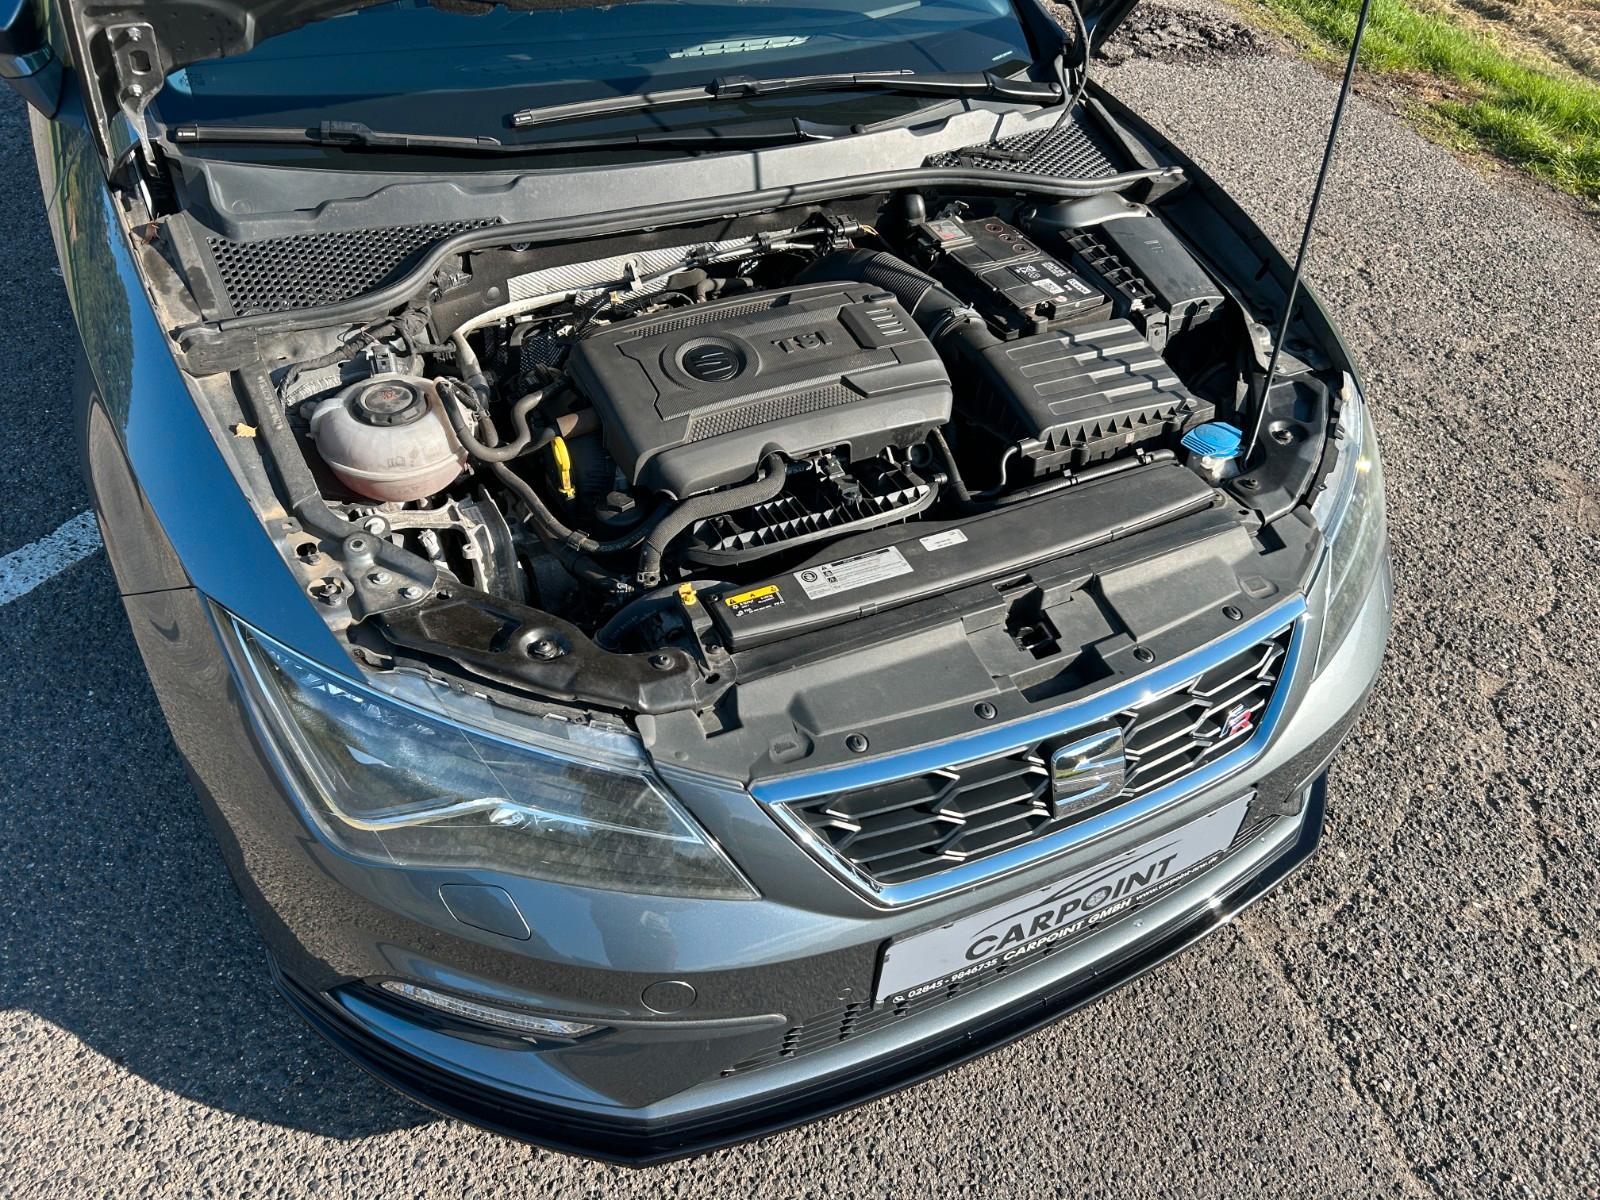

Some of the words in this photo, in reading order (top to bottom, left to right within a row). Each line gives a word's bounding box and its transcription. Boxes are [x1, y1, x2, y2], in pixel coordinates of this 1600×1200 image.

[771, 331, 832, 354] TSI
[908, 981, 943, 998] 02845
[951, 959, 998, 983] 9846735
[1003, 921, 1087, 961] CARPOINT
[1088, 898, 1132, 924] GMBH
[965, 853, 1178, 960] CARPOINT
